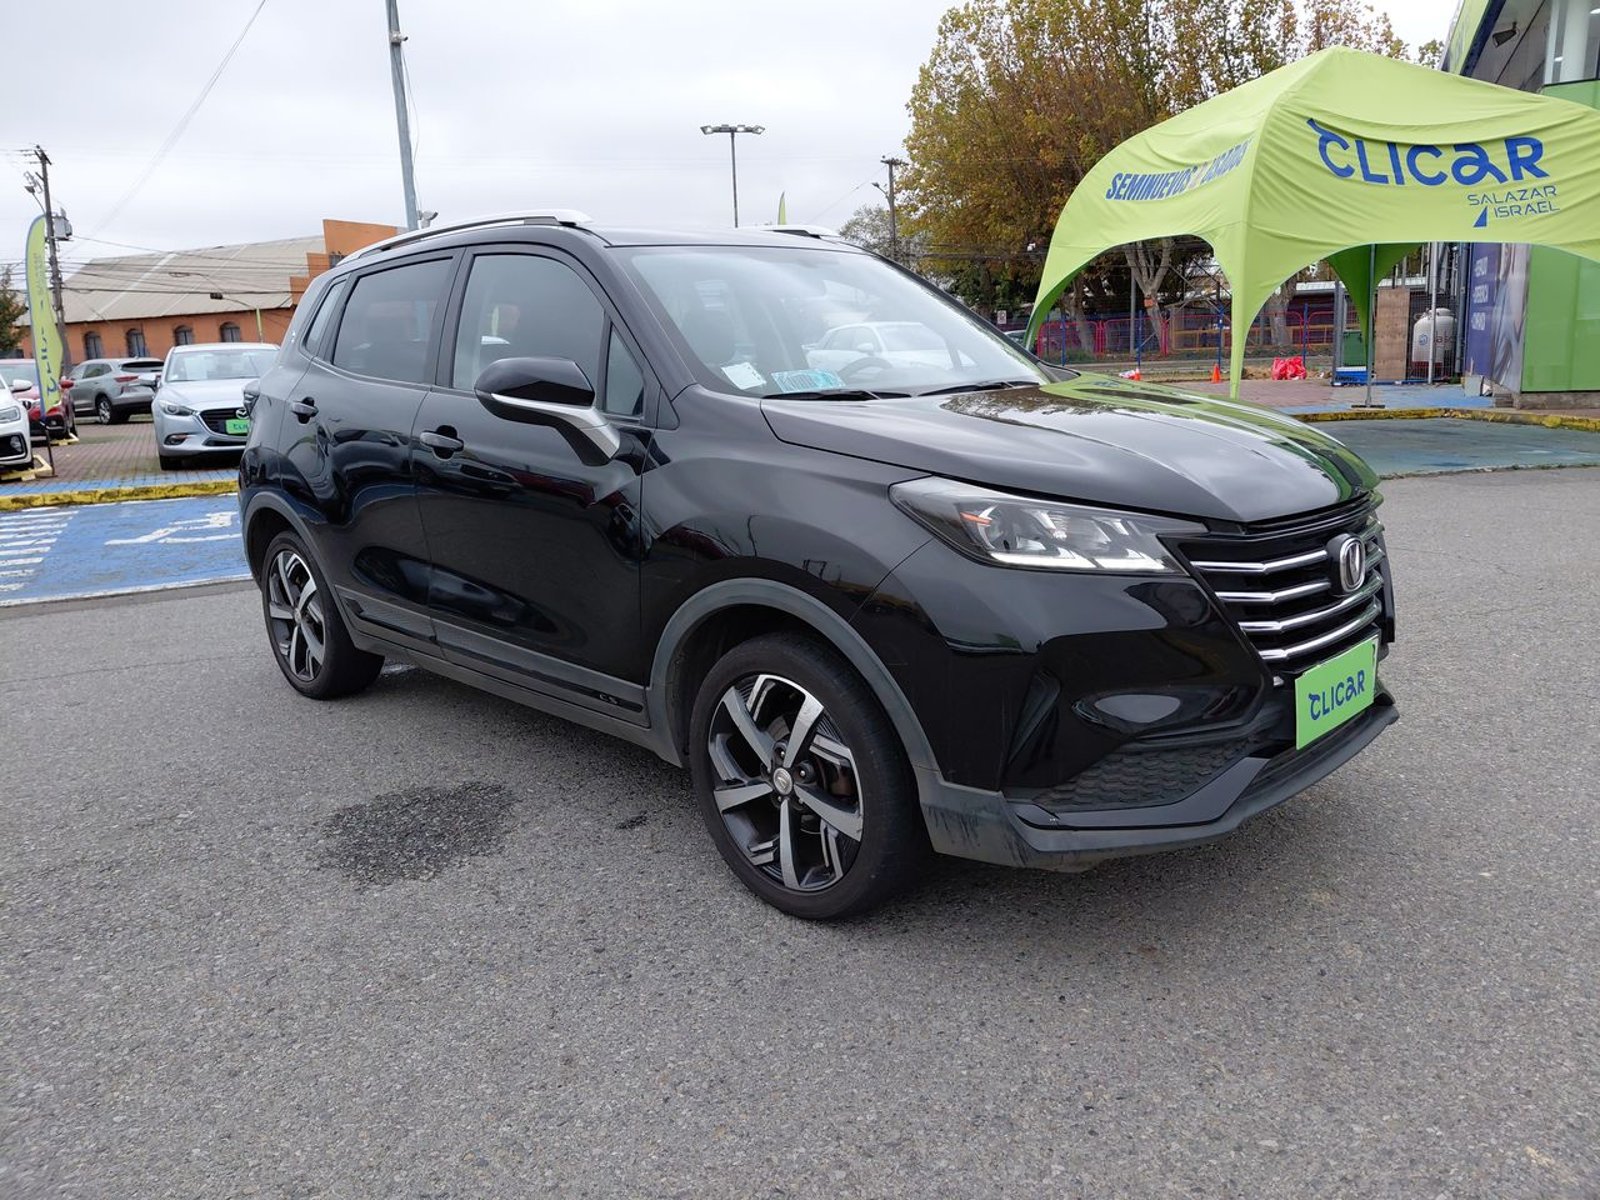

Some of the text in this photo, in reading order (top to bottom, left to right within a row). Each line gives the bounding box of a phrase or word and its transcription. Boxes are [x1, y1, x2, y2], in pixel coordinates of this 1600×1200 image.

[1105, 165, 1199, 201] SEMINUEVOS
[1467, 185, 1557, 206] SALAZAR
[1494, 201, 1560, 218] ISRAEL
